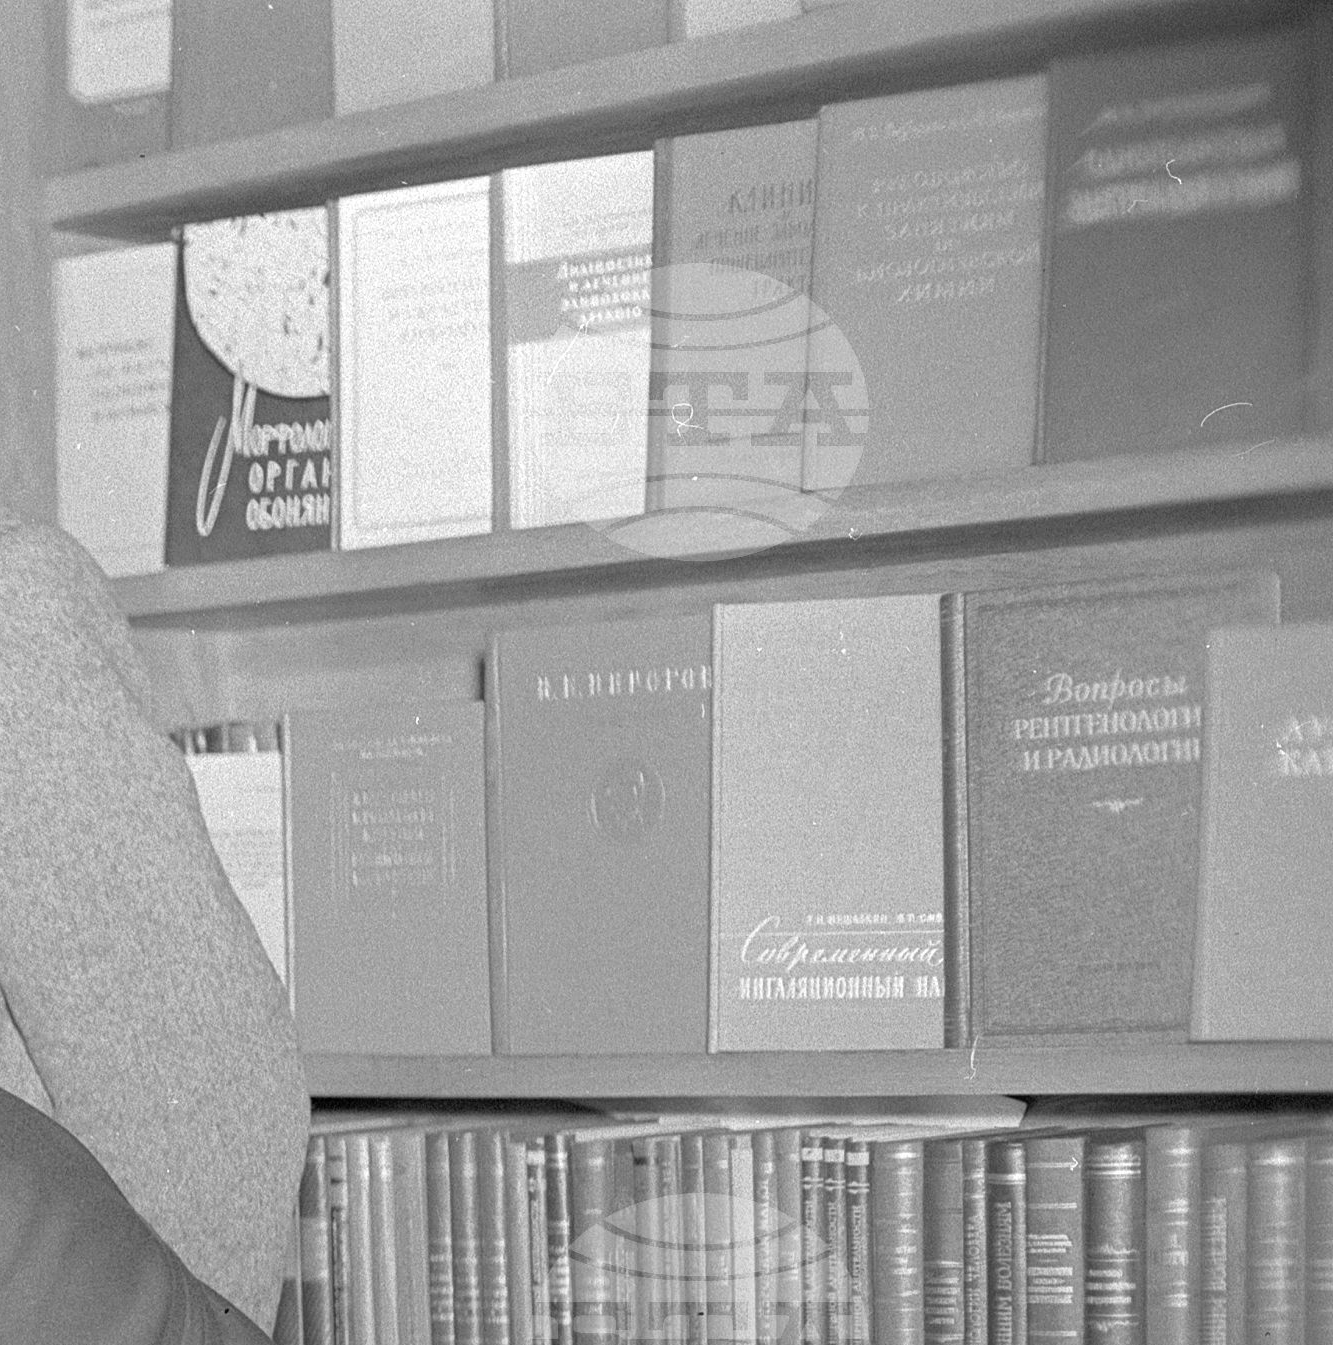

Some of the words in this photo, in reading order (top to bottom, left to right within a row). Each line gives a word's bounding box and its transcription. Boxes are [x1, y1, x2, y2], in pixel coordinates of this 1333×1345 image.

[245, 493, 331, 531] ОБОНЯН
[1042, 668, 1189, 709] Вопросы
[1023, 748, 1040, 772] И
[741, 915, 944, 973] Современный
[739, 974, 904, 999] ИНГАЛЯЦИОННЫЙ
[995, 1201, 1012, 1291] БОЛЕЗНЯМ
